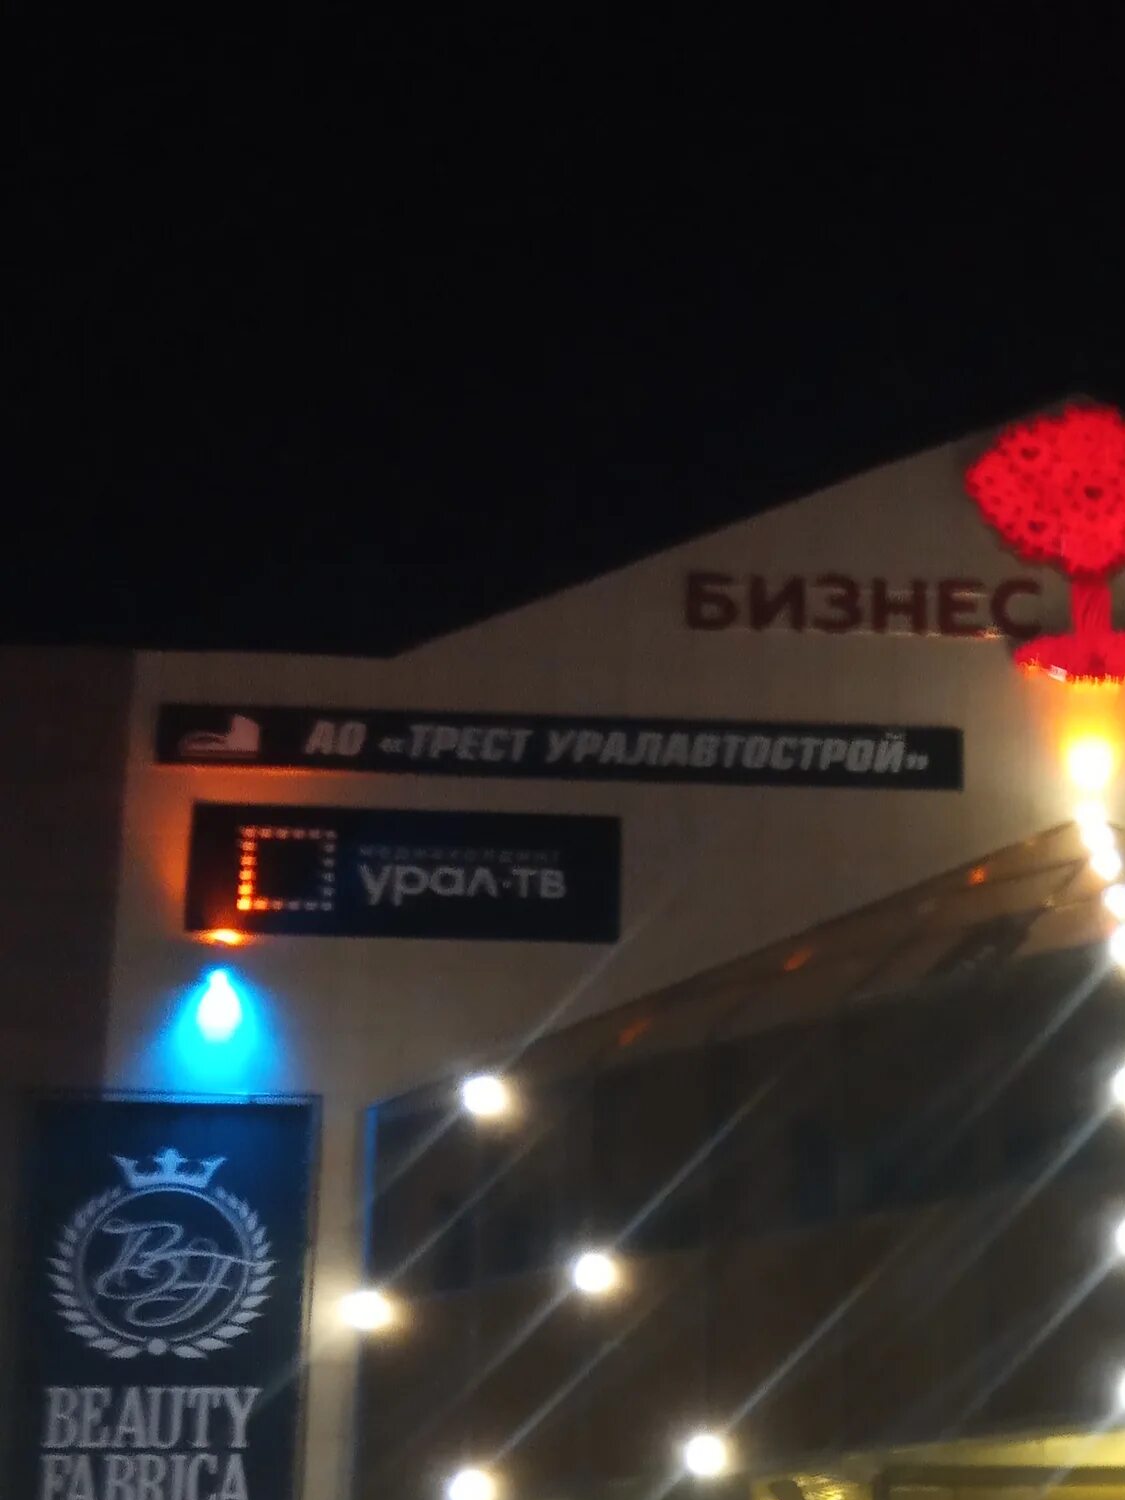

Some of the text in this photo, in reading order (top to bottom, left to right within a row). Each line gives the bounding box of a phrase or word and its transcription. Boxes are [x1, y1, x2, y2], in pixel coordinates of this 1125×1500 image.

[684, 571, 1042, 638] БИЗНЕС
[305, 720, 368, 757] АО
[41, 1386, 263, 1449] BEAUTY
